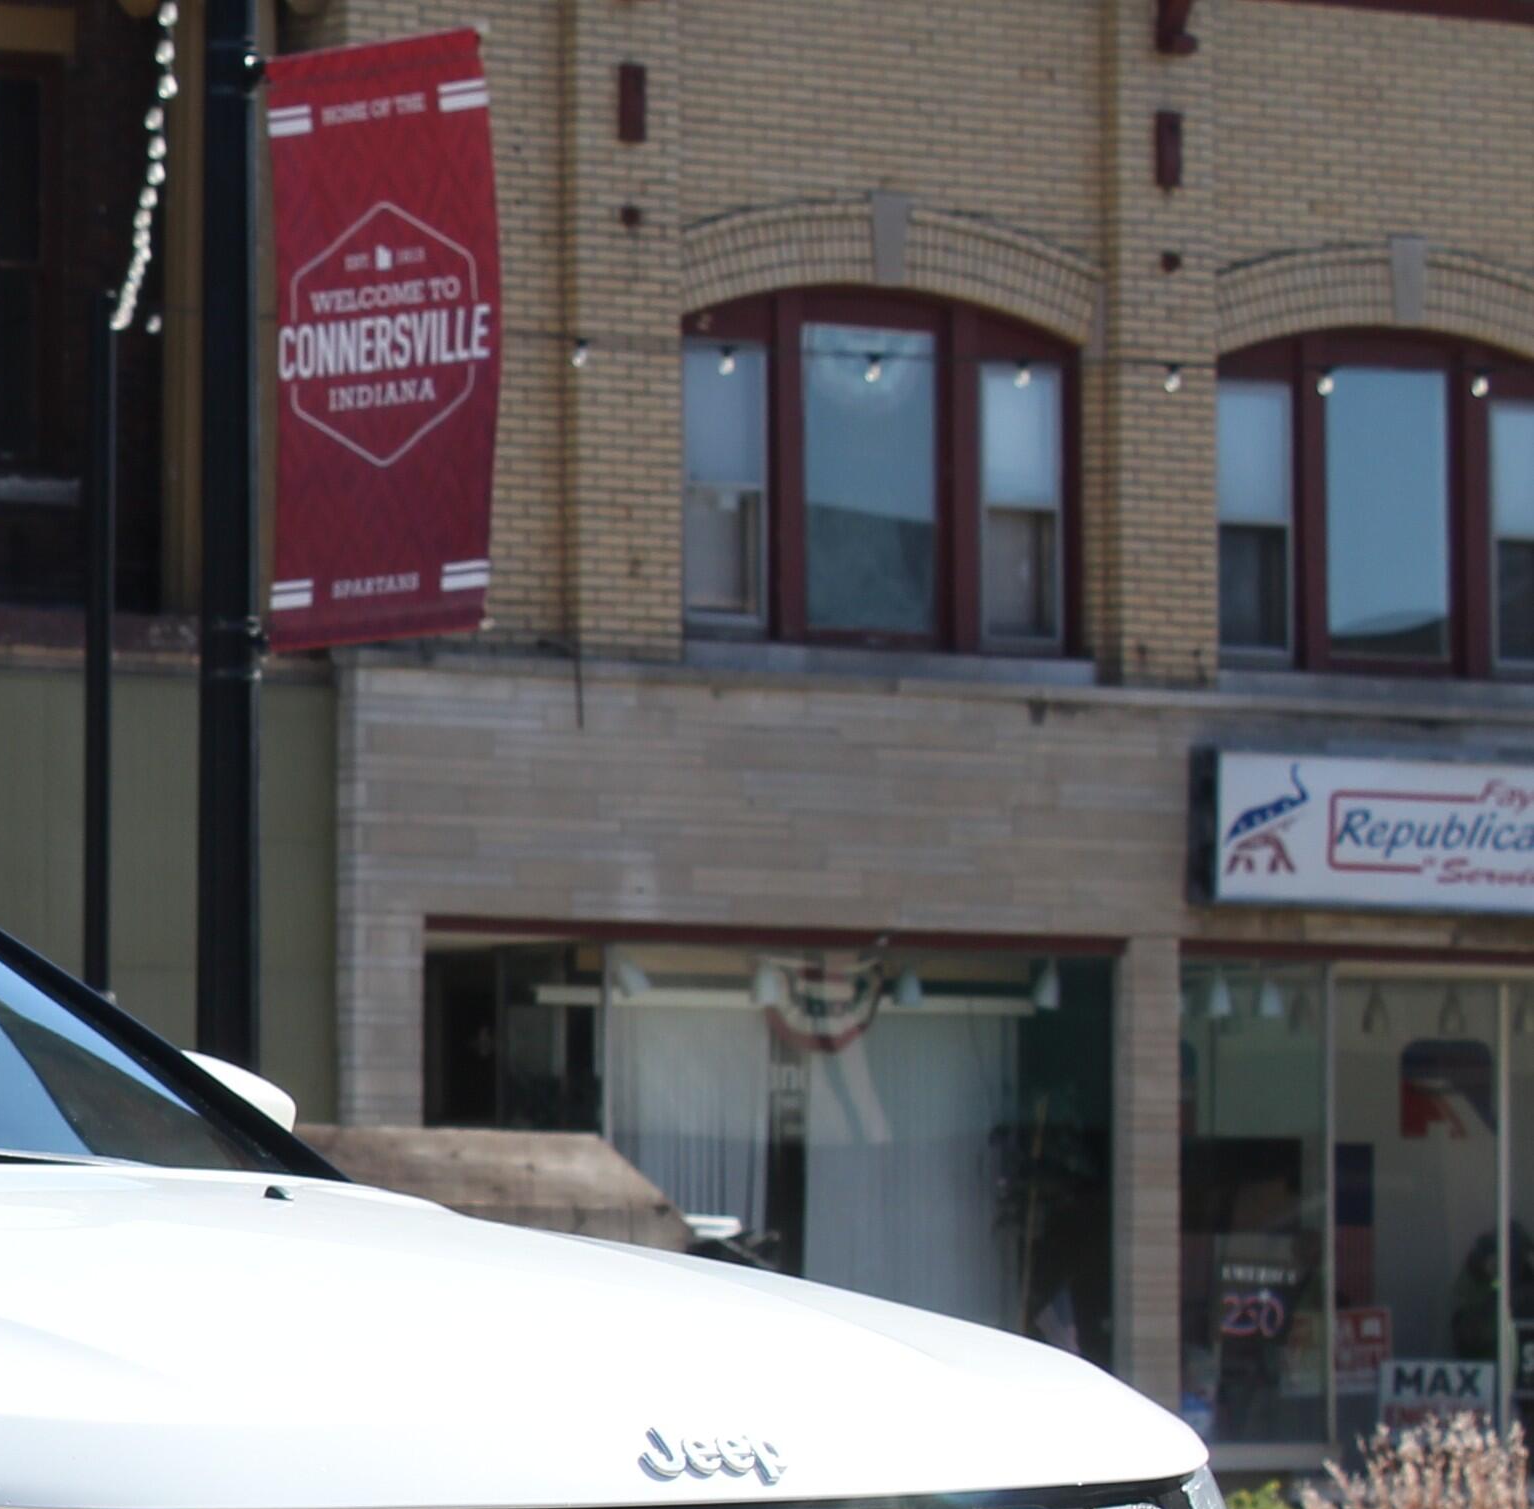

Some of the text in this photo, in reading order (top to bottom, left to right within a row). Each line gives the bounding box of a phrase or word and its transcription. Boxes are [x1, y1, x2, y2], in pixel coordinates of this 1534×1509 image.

[309, 275, 461, 314] WELCOME TO
[277, 303, 491, 382] CONNERSVILLE
[328, 377, 436, 412] INDIANA
[331, 571, 421, 600] SPARTANS
[1393, 1366, 1481, 1398] MAX
[638, 1426, 789, 1487] Jeep
